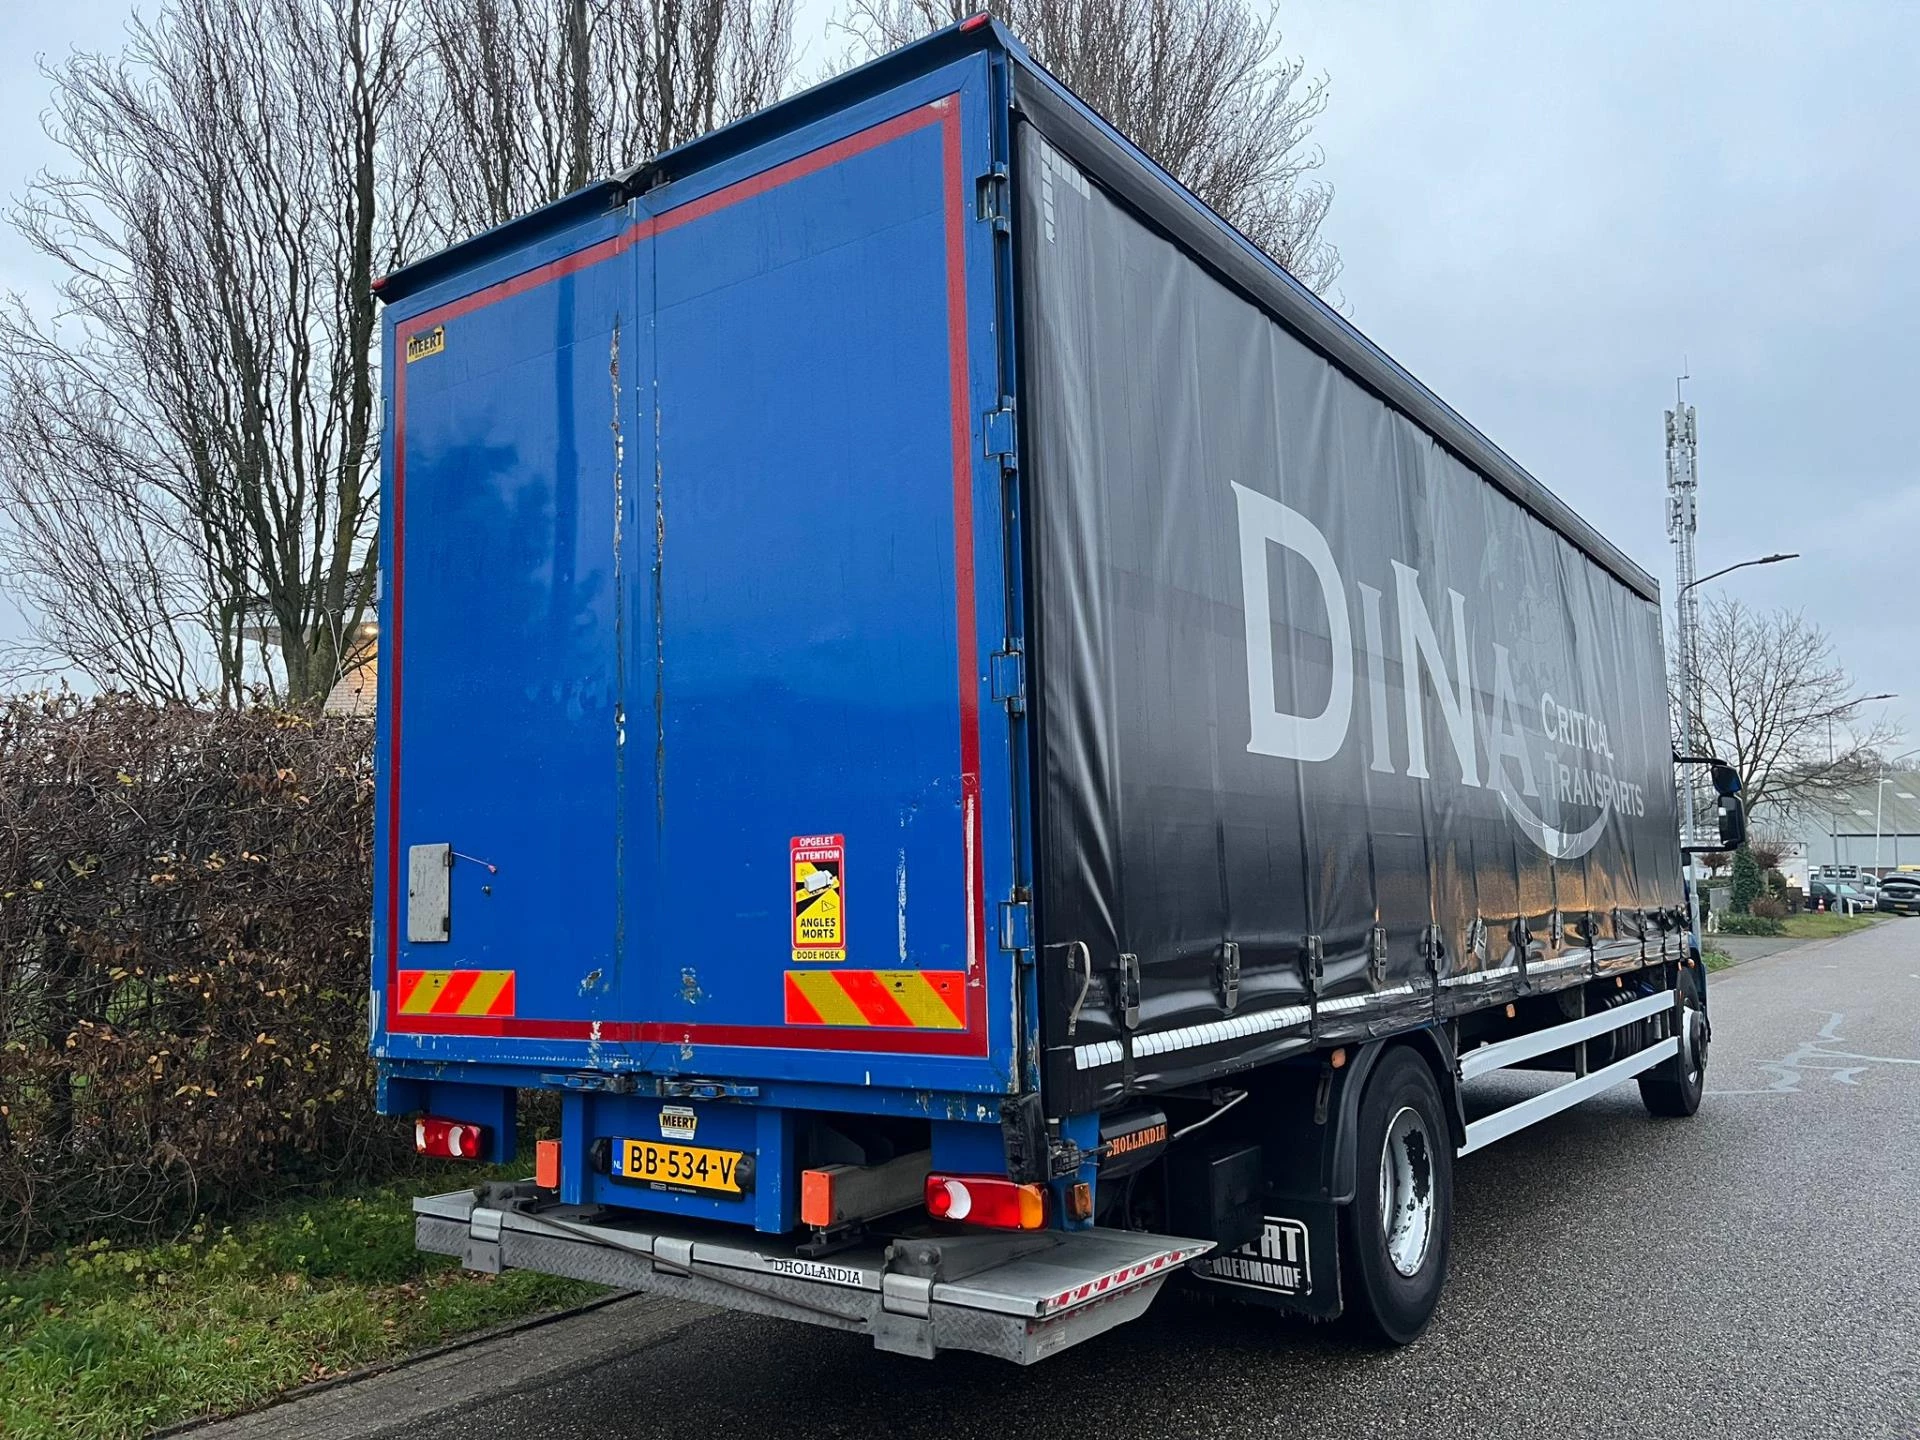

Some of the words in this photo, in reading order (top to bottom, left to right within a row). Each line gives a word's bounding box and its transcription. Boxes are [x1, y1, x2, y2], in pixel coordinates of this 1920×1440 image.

[1541, 692, 1614, 760] CRITICAL
[1544, 751, 1645, 818] TRANSPORTS
[799, 836, 834, 847] OPGELET
[795, 850, 840, 861] ATTENTION
[800, 918, 836, 928] ANGLES
[802, 929, 835, 939] MORTS
[796, 951, 817, 960] DODE
[819, 951, 840, 960] HOEK
[662, 1115, 695, 1129] MEERT
[613, 1160, 622, 1170] NL
[630, 1145, 733, 1185] BB-534-V
[774, 1260, 862, 1285] DHOLLANDIA
